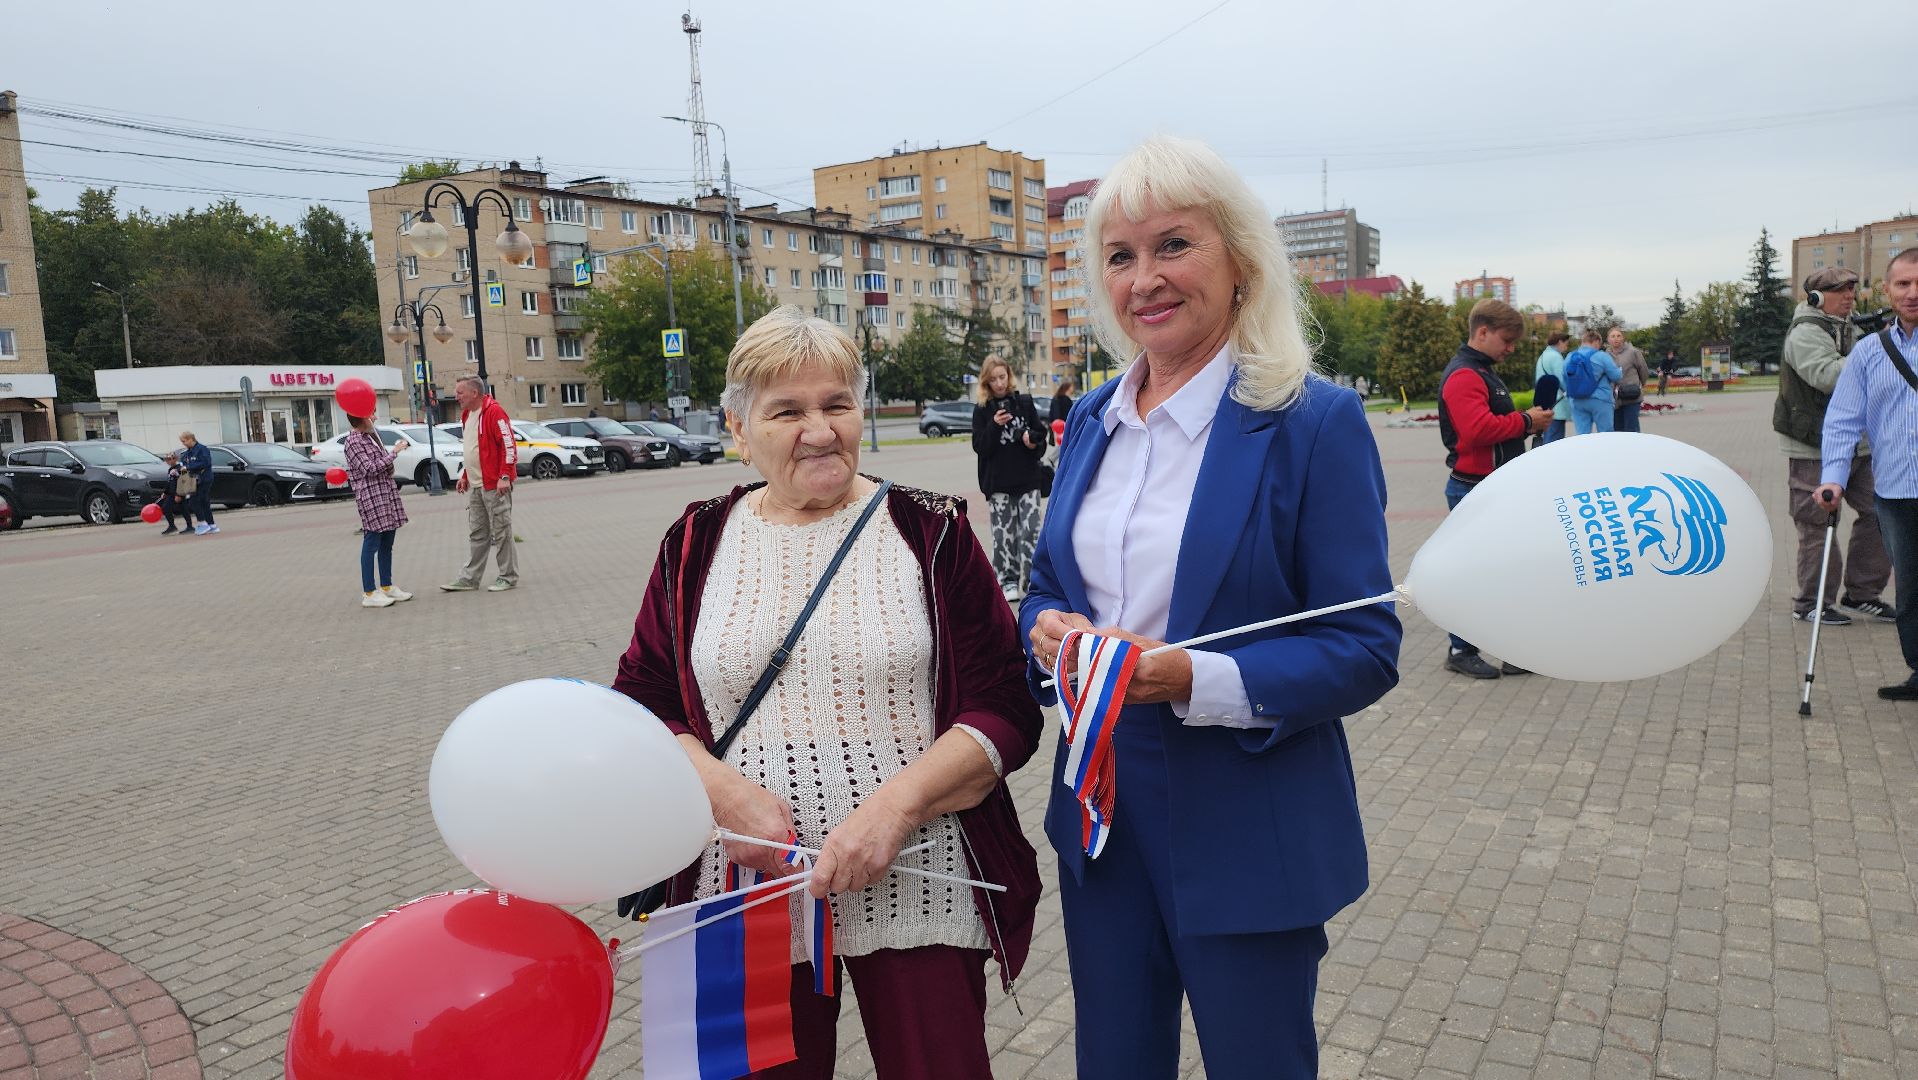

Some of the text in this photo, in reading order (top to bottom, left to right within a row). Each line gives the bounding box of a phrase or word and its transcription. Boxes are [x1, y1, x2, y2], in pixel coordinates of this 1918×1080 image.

[270, 373, 335, 387] ЦВЕТЫ
[1554, 497, 1588, 588] ПОДМОСКОВЬЕ
[1572, 491, 1613, 582] РОССИЯ
[1594, 487, 1634, 578] ЕДИНАЯ
